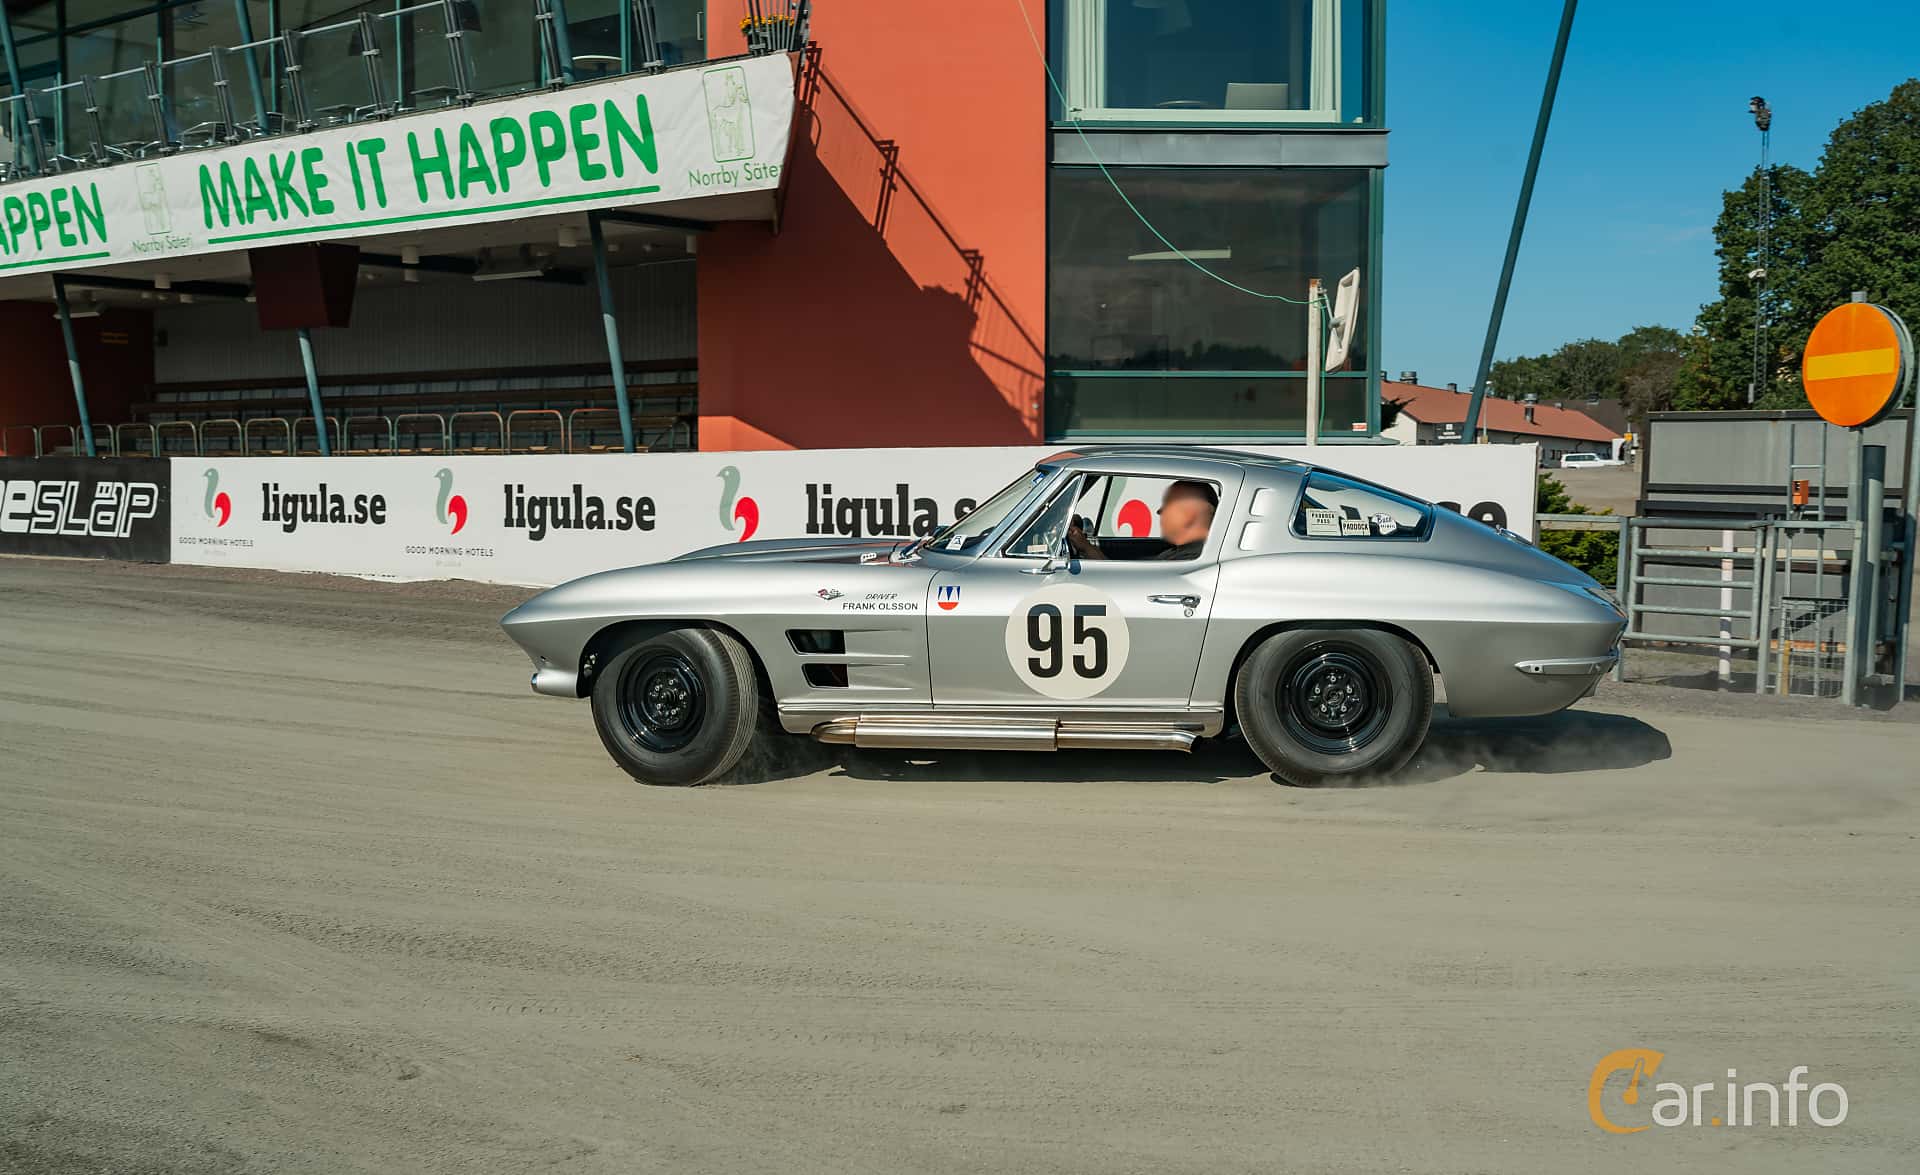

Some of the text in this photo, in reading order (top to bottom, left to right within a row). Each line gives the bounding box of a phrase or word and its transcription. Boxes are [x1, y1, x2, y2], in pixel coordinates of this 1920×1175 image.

[199, 93, 659, 230] MAKE IT HAPPEN
[688, 165, 739, 188] Norrby
[262, 482, 387, 533] ligula.se
[503, 484, 656, 541] ligula.se
[406, 545, 494, 557] GOOD MORNING HOTELS
[842, 602, 918, 610] FRANK OLSSON
[1027, 603, 1108, 679] 95
